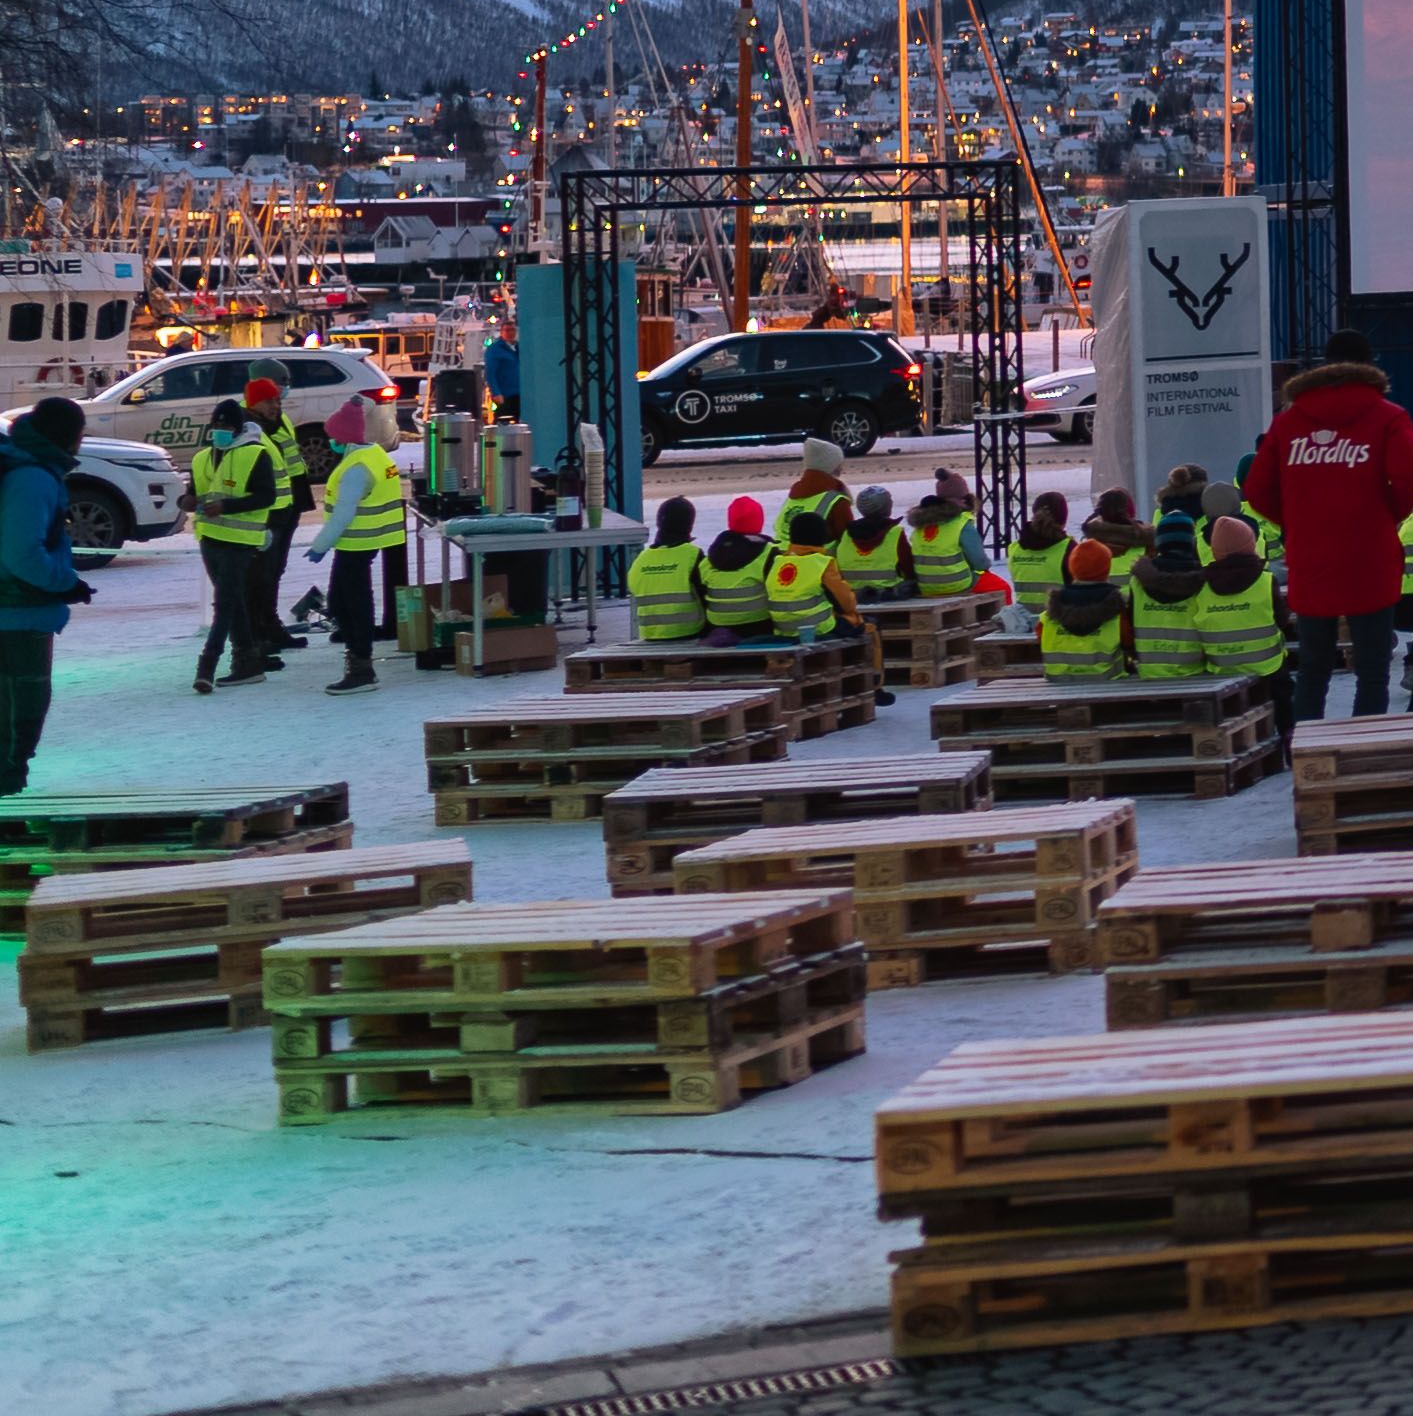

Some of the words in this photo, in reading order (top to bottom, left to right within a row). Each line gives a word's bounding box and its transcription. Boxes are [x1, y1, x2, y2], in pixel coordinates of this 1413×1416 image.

[1147, 371, 1199, 384] TROMSØ
[1147, 387, 1240, 403] INTERNATIONAL
[714, 405, 737, 414] TAXI
[1147, 404, 1175, 417] FILM
[1177, 402, 1233, 415] FESTIVAL
[161, 413, 191, 430] din
